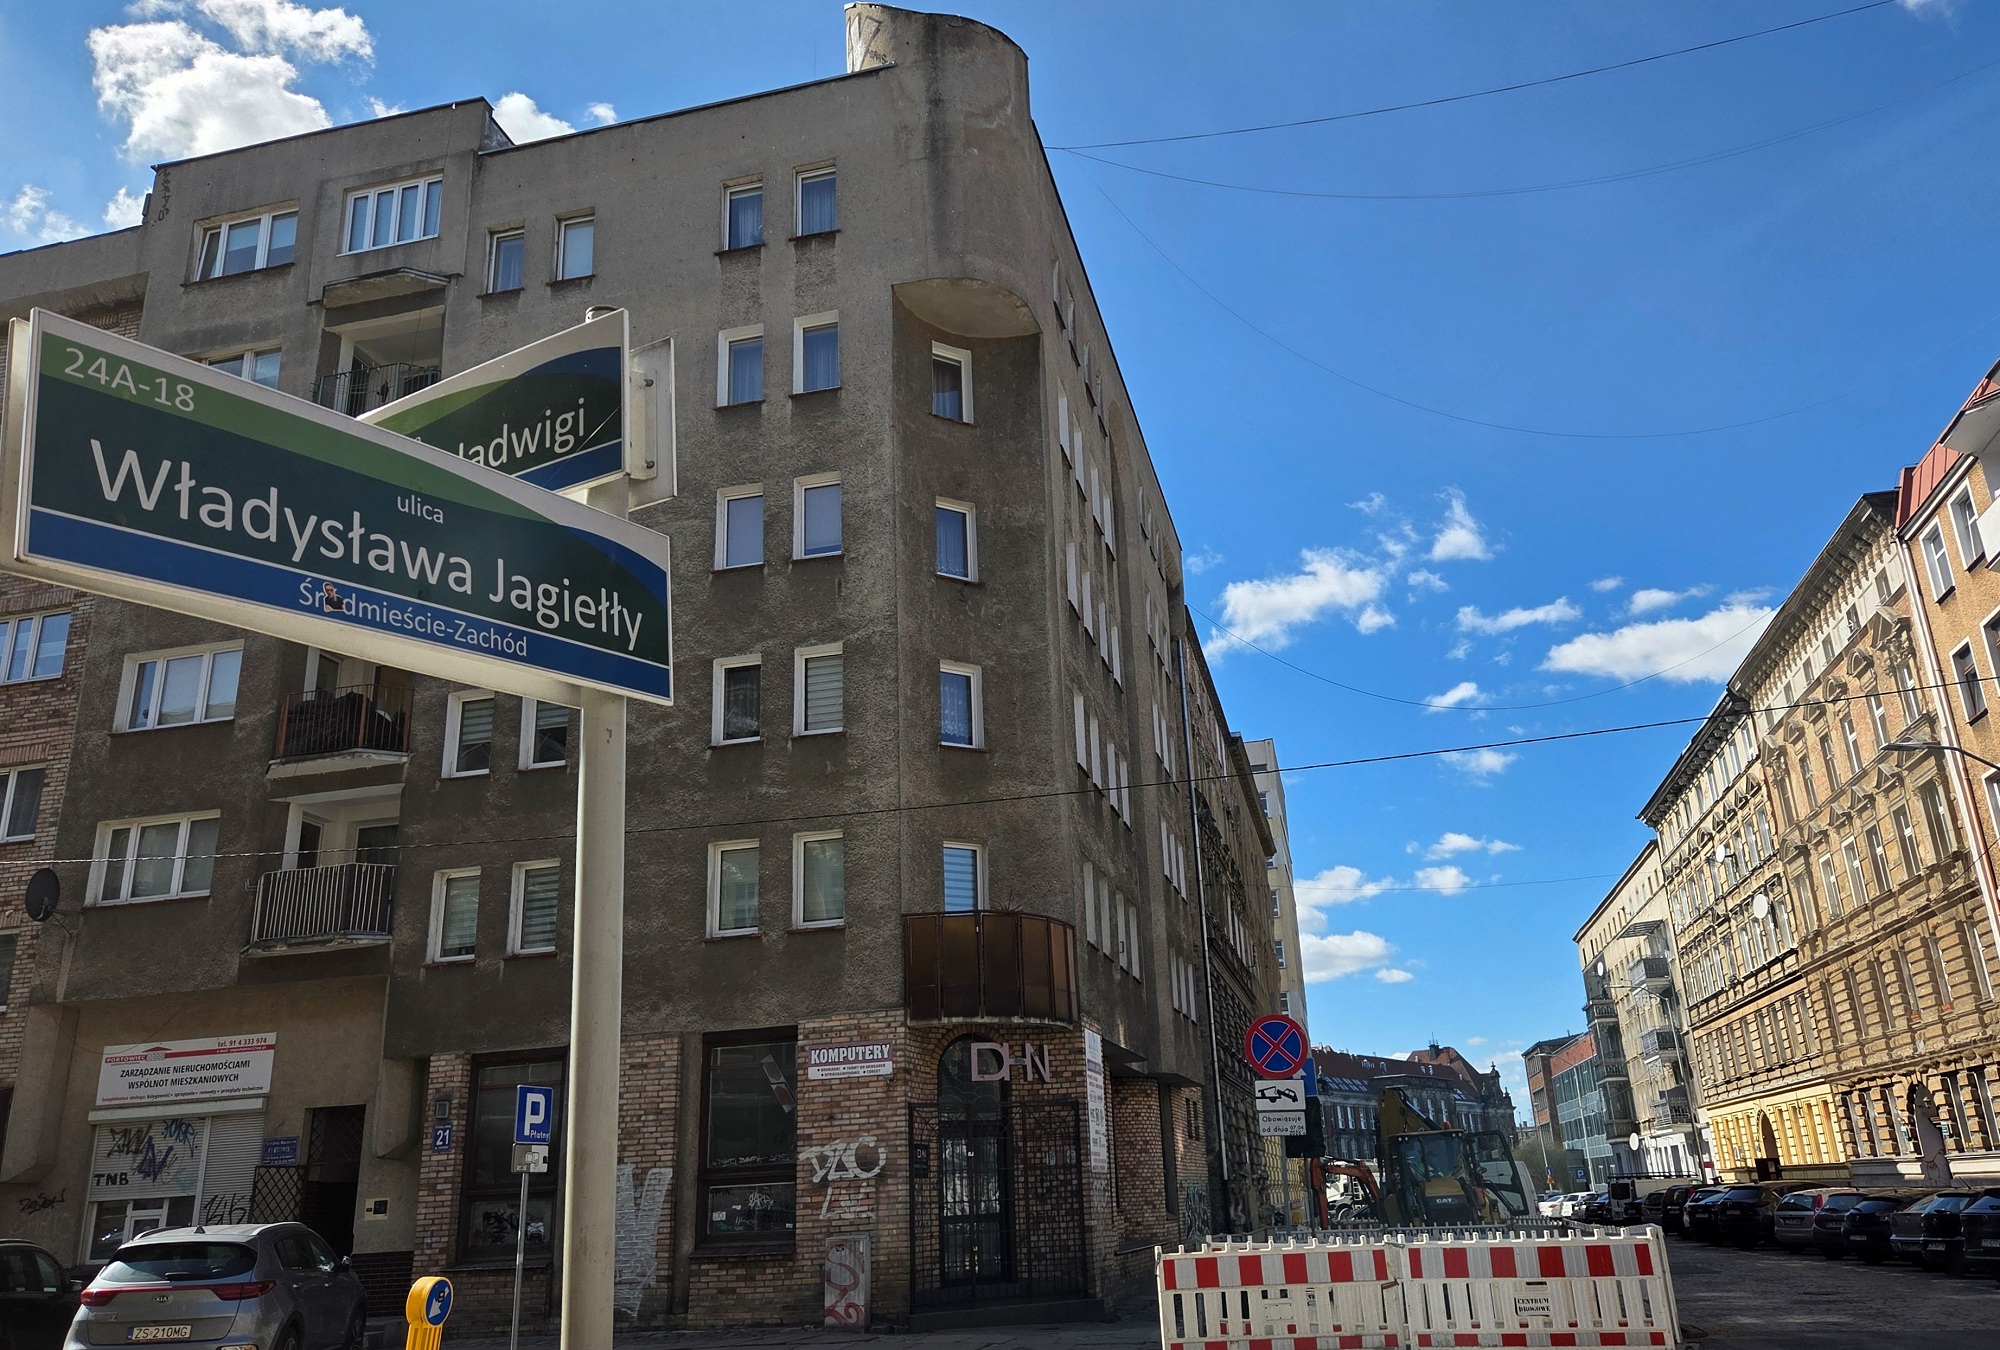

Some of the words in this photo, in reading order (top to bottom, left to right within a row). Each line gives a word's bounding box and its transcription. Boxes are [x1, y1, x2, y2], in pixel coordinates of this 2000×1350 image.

[64, 347, 195, 412] 24A-18
[397, 494, 444, 524] ulica
[90, 437, 472, 595] Władysława
[489, 558, 643, 651] Jagiełły
[299, 577, 527, 657] Śrdmieście-Zachód
[217, 1040, 228, 1048] tel.
[229, 1039, 237, 1047] 91
[237, 1039, 243, 1047] 4
[243, 1037, 255, 1046] 333
[255, 1037, 267, 1045] 974
[106, 1054, 146, 1063] PORTOWIEC
[810, 1043, 890, 1065] KOMPUTERY
[120, 1066, 171, 1079] ZARZĄDZANIE
[172, 1059, 251, 1074] NIERUCHOMOŚCIAMI
[128, 1077, 168, 1090] WSPÓLNOT
[170, 1073, 239, 1087] MIESZKANIOWYCH
[523, 1092, 546, 1136] P
[436, 1129, 450, 1146] 21
[530, 1130, 550, 1141] Płatny
[93, 1172, 129, 1186] TNB
[1517, 1297, 1549, 1305] CENTRUM
[134, 1327, 149, 1339] ZS
[153, 1326, 188, 1338] 210MG
